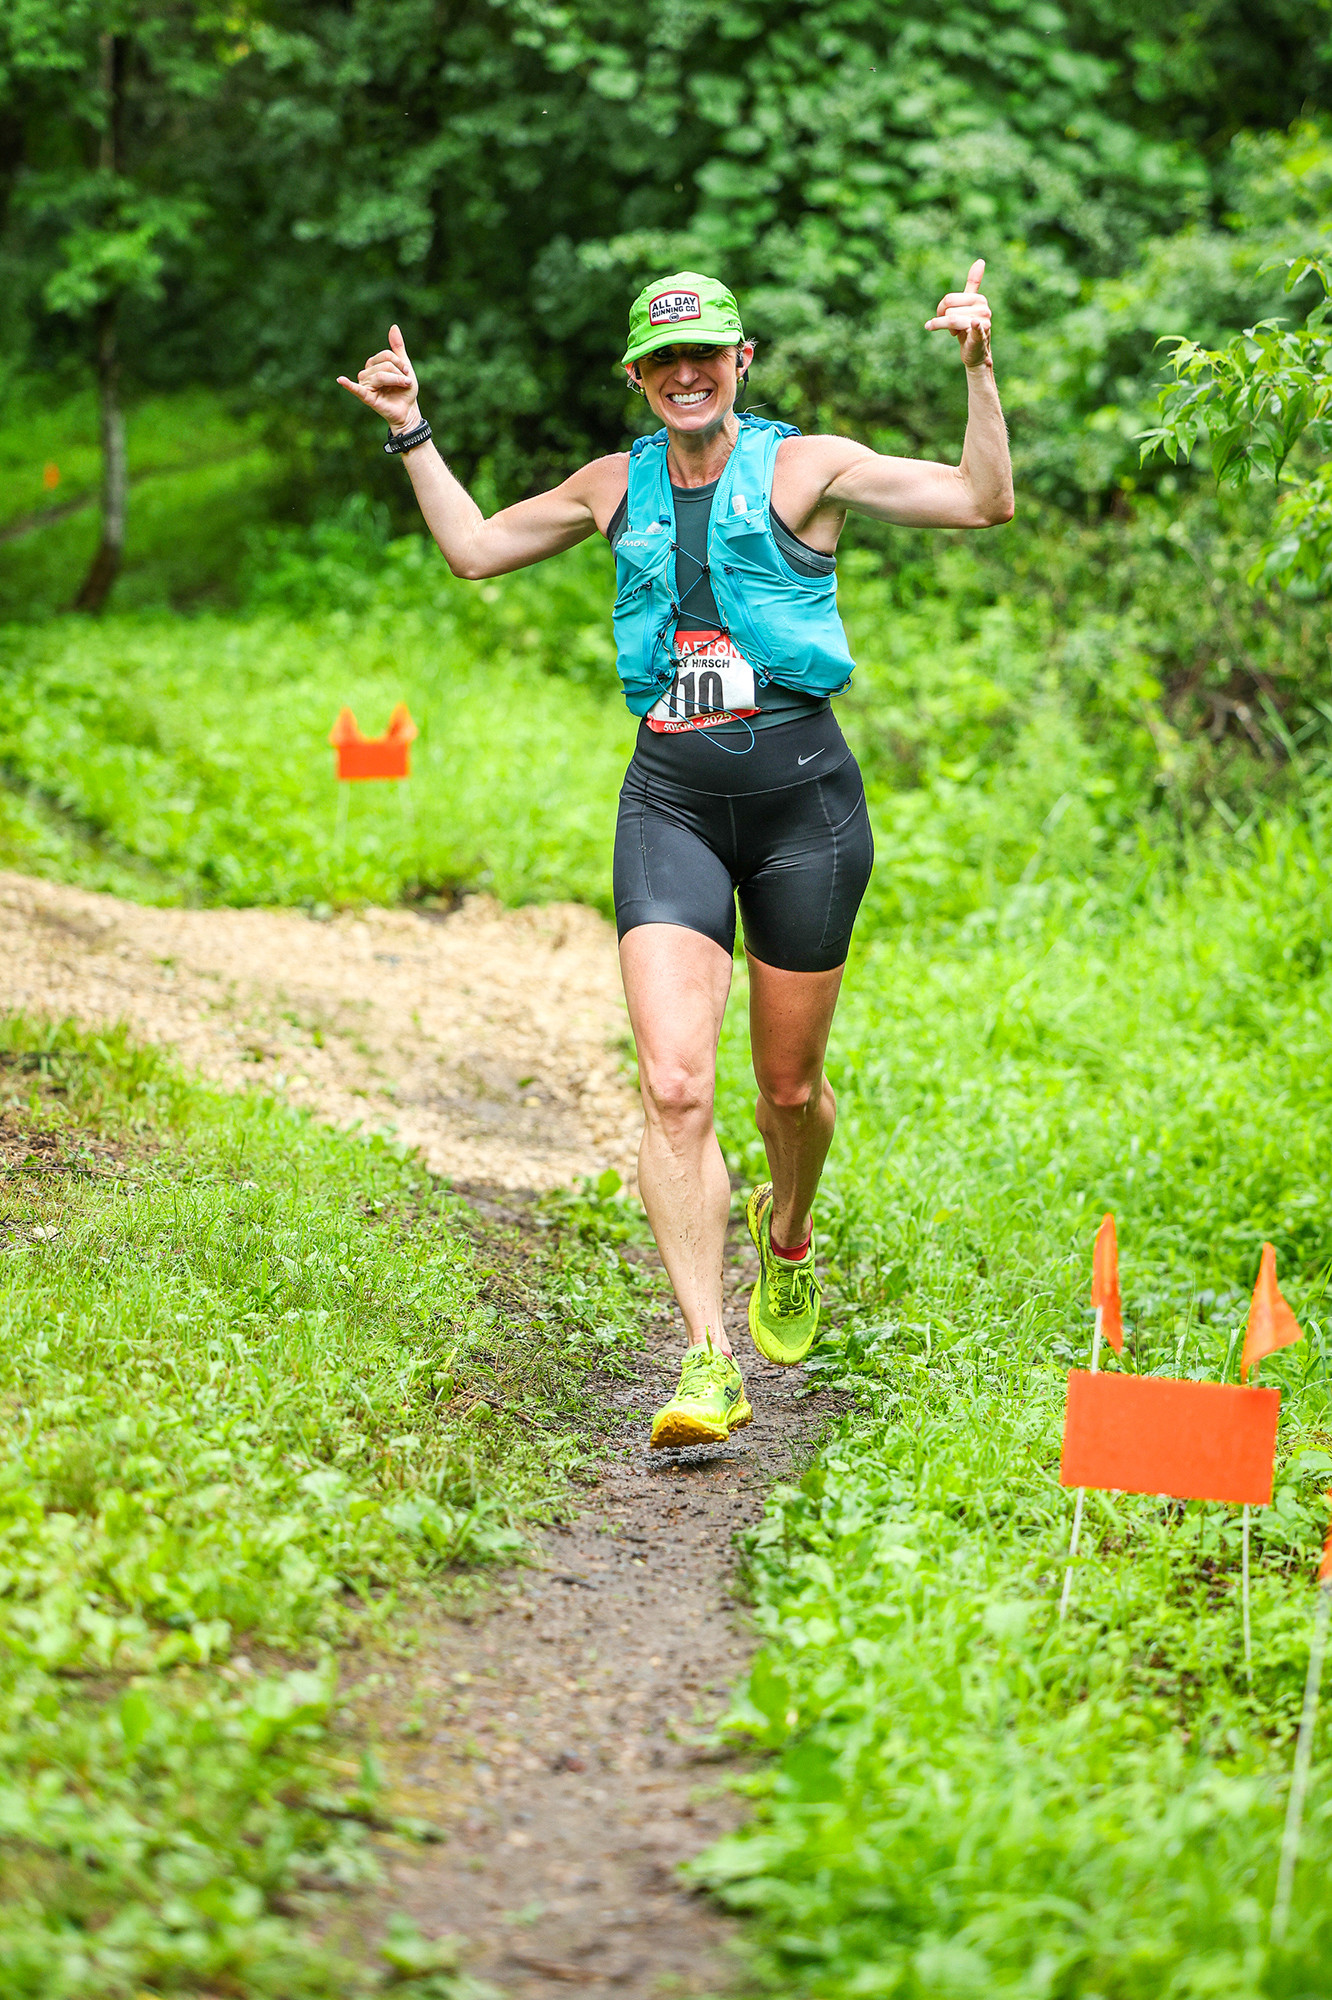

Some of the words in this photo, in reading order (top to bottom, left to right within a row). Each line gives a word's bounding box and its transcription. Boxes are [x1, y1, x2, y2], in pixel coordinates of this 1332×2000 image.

[652, 299, 671, 312] ALL
[674, 297, 696, 306] DAY
[651, 306, 684, 319] RUNNING
[685, 305, 698, 313] CO.
[692, 658, 730, 668] HIRSCH
[702, 712, 732, 727] 2025
